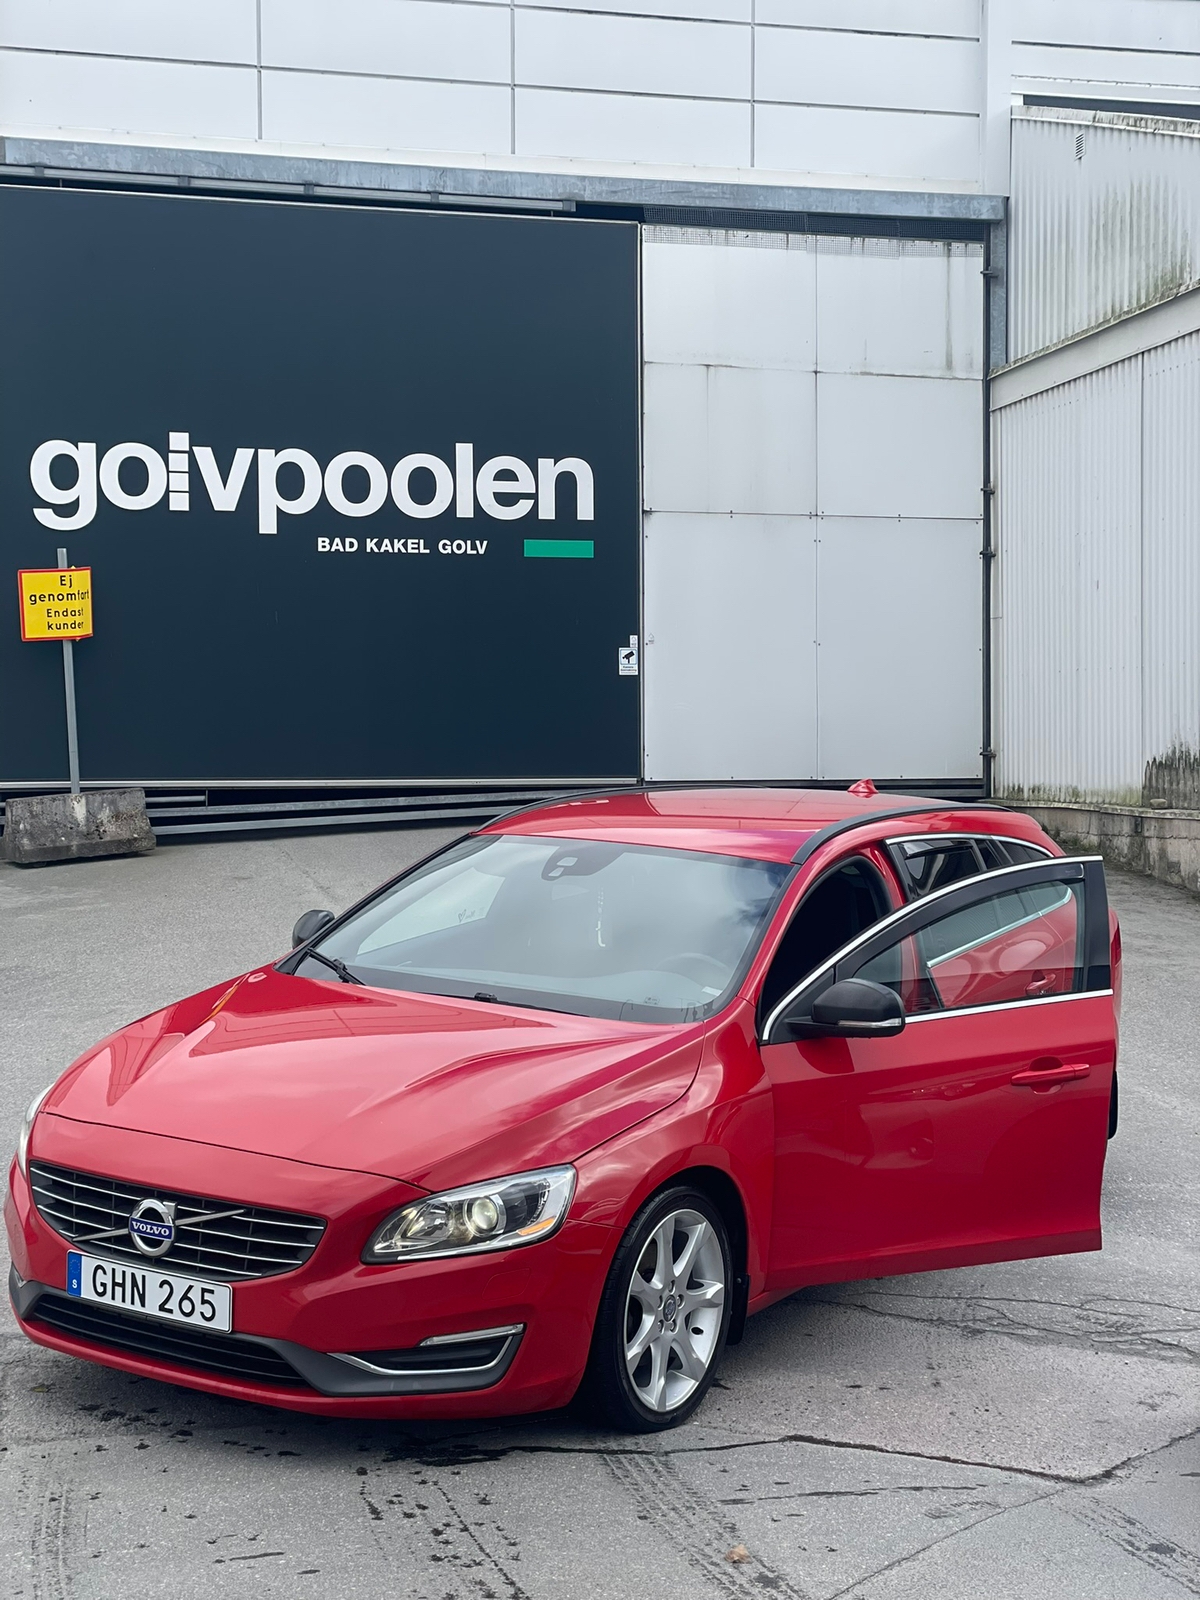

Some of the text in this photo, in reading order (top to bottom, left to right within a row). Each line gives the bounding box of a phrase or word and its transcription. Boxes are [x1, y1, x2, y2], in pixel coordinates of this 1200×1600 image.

[30, 432, 594, 534] golvpoolen
[317, 537, 488, 555] BAD KAKEL GOLV
[59, 575, 73, 588] Ej
[46, 608, 84, 618] Endast
[47, 620, 84, 630] kunder
[131, 1220, 170, 1237] VOLVO
[72, 1279, 78, 1289] S
[92, 1264, 216, 1323] GHN 265
